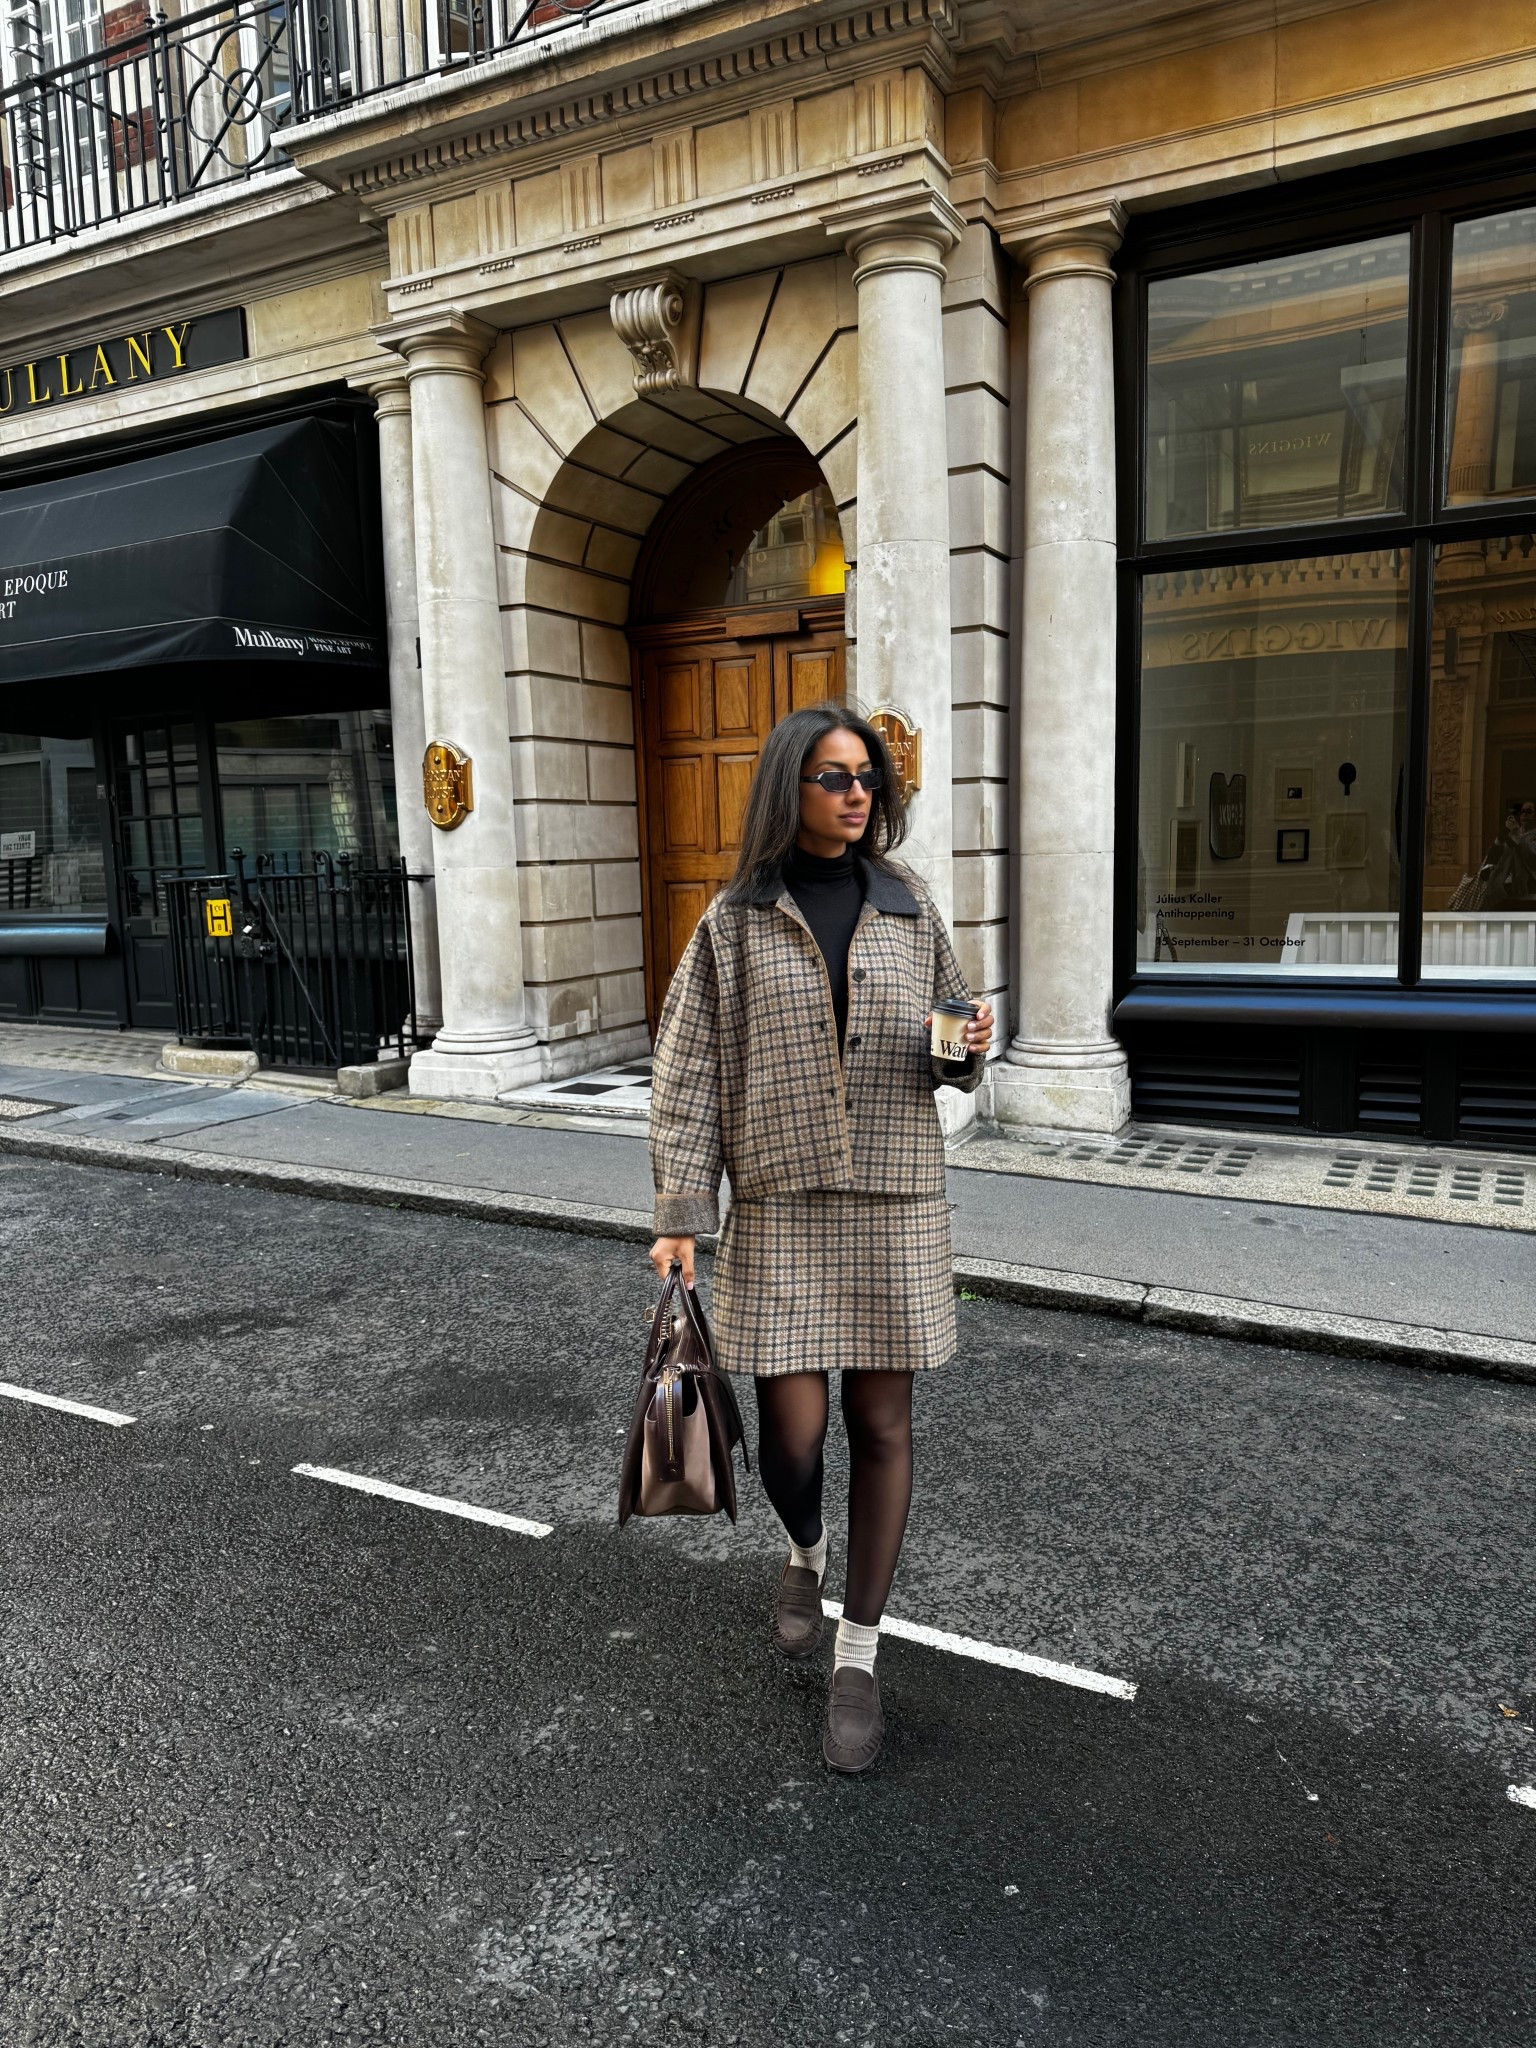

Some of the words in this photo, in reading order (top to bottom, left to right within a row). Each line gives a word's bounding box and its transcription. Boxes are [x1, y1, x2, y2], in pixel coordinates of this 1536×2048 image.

[4, 570, 68, 596] EPOQUE
[232, 626, 304, 656] Mullany
[313, 643, 336, 653] FINE
[336, 646, 352, 655] ART
[1156, 894, 1187, 904] Július
[1189, 893, 1222, 904] Koller
[1156, 908, 1235, 920] Antihappening
[1156, 937, 1169, 946] 15
[1171, 937, 1229, 948] September
[1243, 937, 1255, 946] 31
[1259, 936, 1306, 947] October
[940, 1040, 968, 1058] Wat
